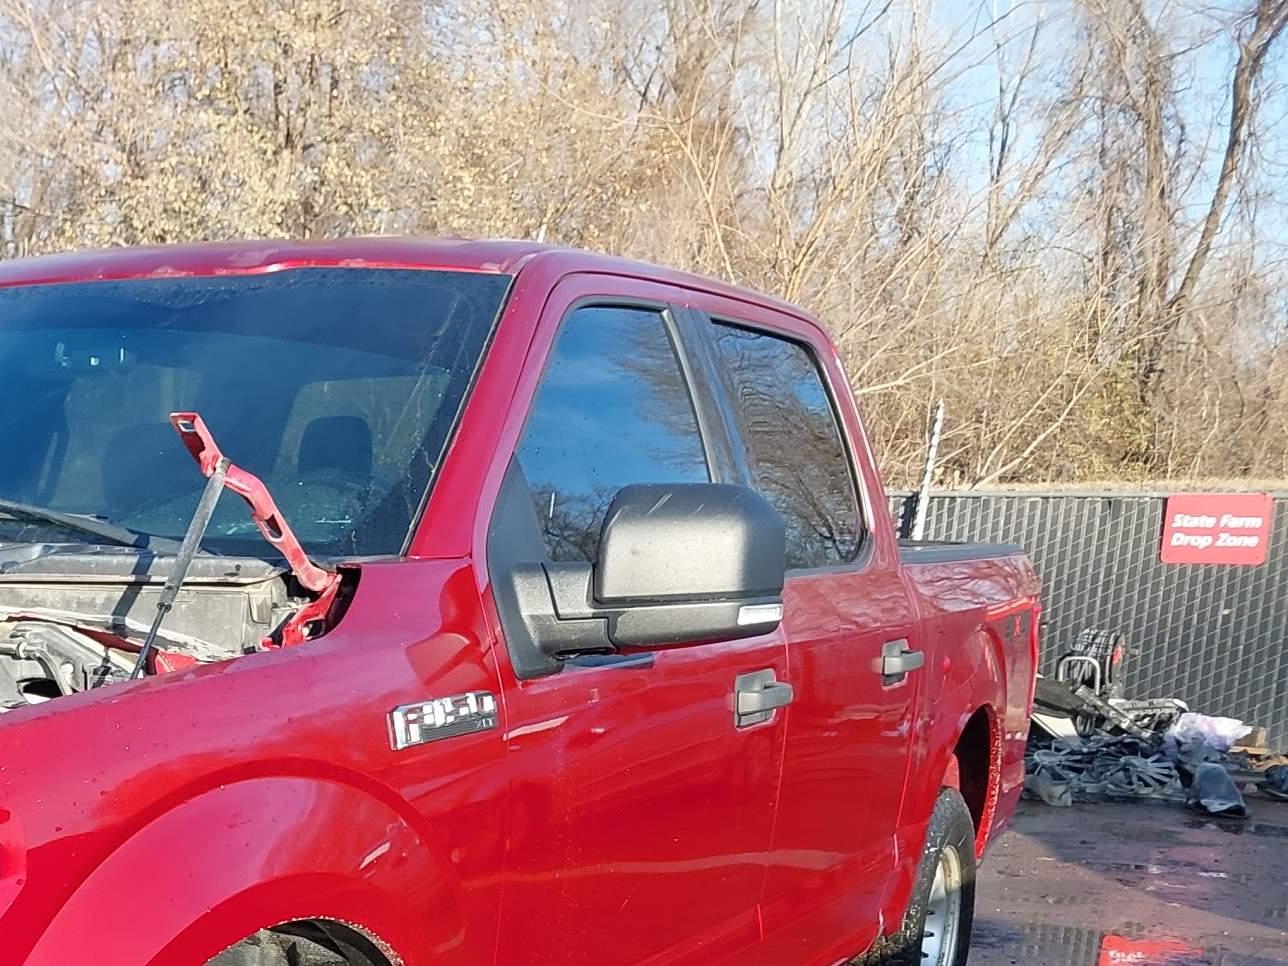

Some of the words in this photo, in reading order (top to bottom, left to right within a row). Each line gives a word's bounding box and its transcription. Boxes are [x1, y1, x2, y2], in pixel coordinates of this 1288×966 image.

[1171, 513, 1216, 528] State
[1219, 514, 1263, 528] Farm
[1170, 532, 1213, 549] Drop
[1215, 532, 1259, 547] Zone
